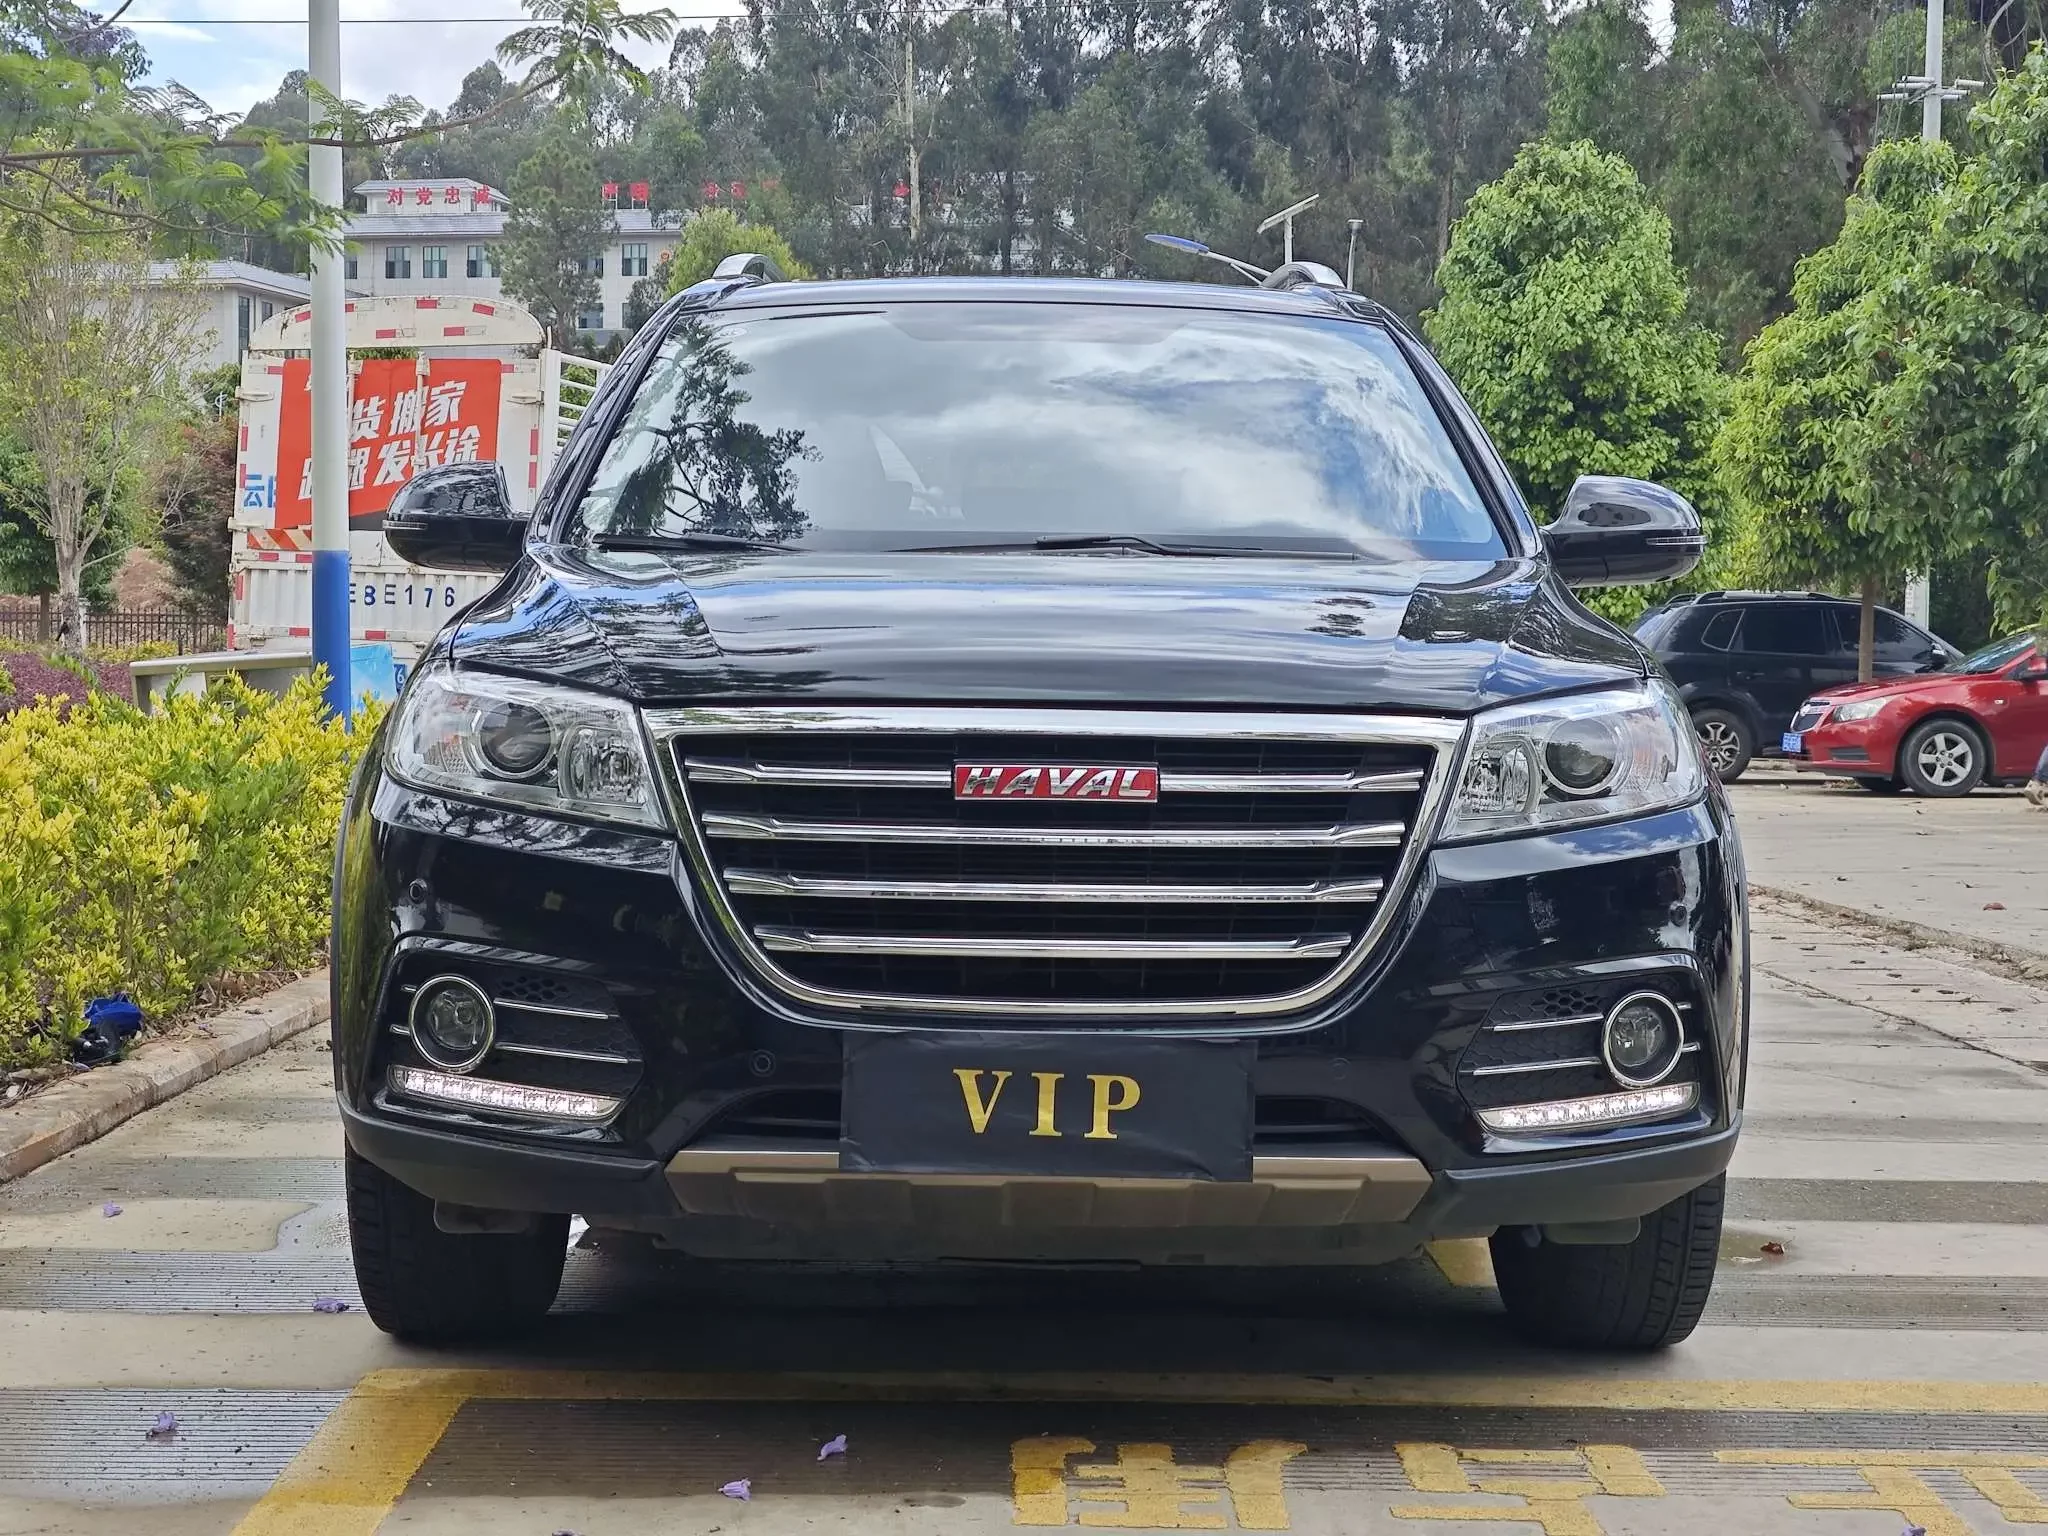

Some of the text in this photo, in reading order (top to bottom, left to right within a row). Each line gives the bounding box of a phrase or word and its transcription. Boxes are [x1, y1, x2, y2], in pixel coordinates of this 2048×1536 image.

[386, 184, 492, 206] 对党忠诚
[243, 474, 275, 508] 云
[961, 767, 1152, 798] HAVAL
[952, 1068, 1142, 1140] VIP
